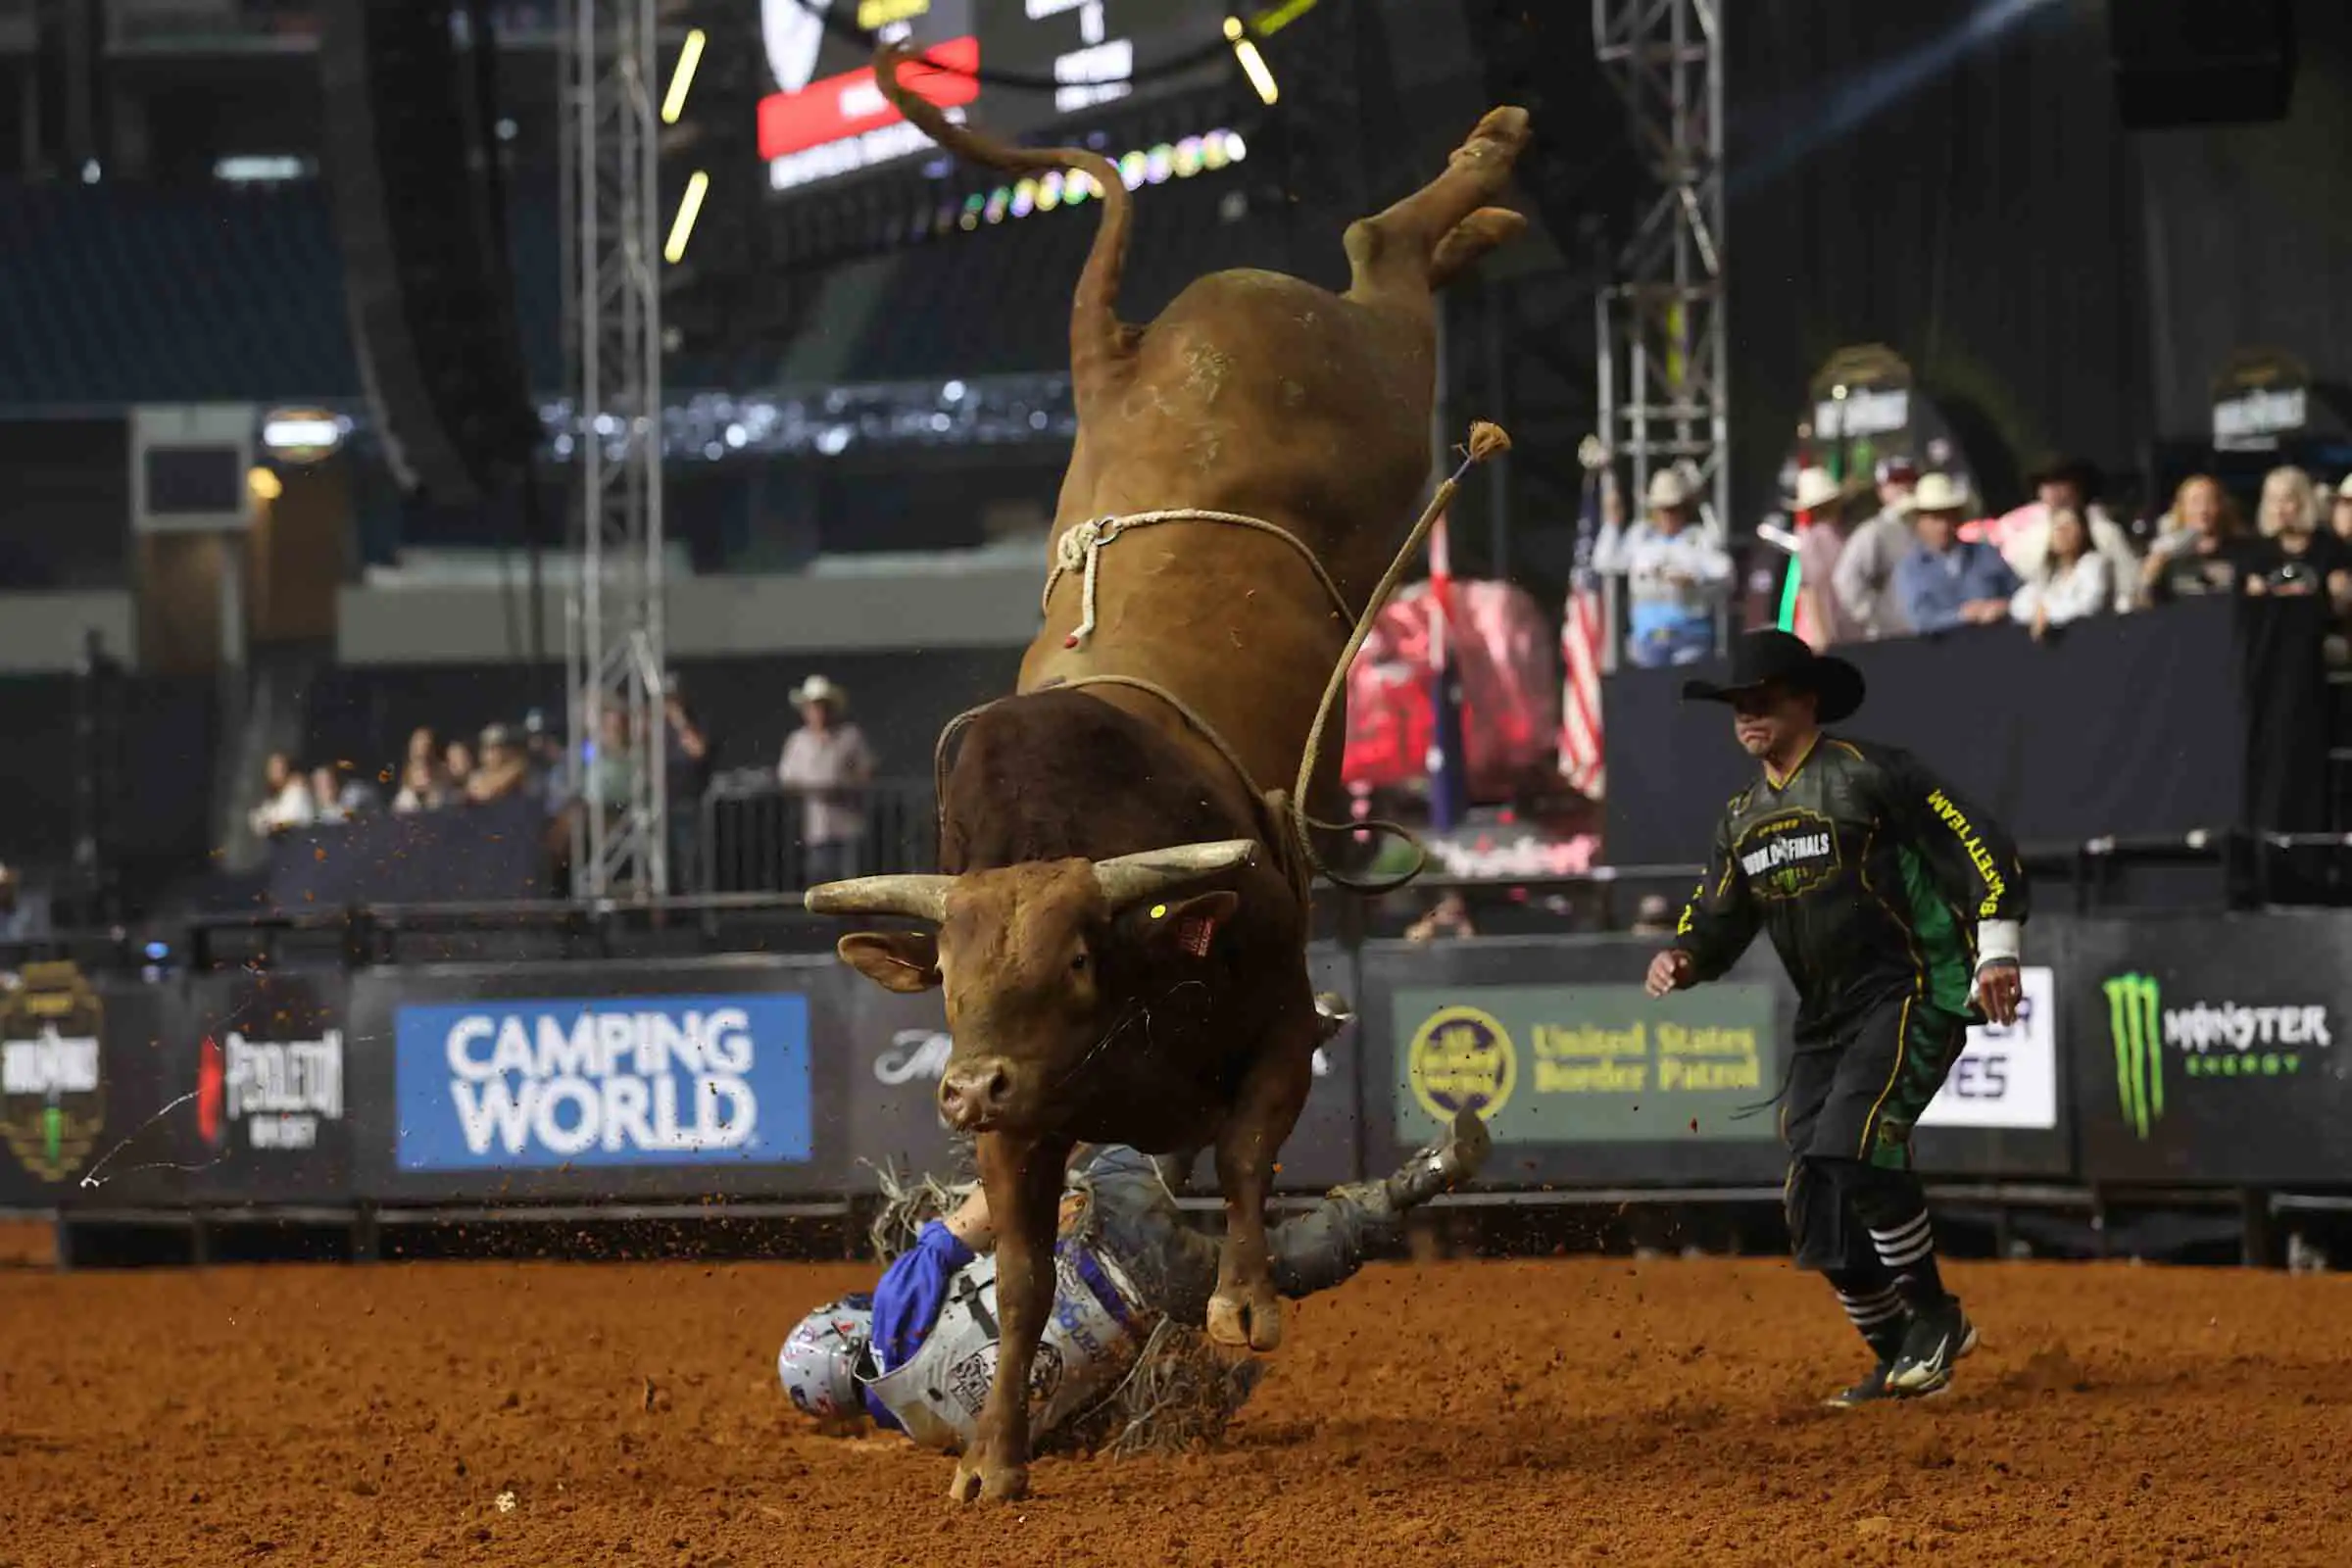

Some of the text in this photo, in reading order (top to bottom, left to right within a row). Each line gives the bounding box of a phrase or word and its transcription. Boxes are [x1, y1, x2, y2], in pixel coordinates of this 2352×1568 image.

[1926, 788, 1972, 840] TEAM
[1786, 832, 1831, 861] FINALS
[446, 1008, 755, 1078] CAMPING
[1532, 1020, 1756, 1055] United States
[2164, 1000, 2332, 1054] MONSTER
[1534, 1057, 1645, 1093] Border
[1659, 1054, 1760, 1092] Patrol
[450, 1072, 758, 1154] WORLD
